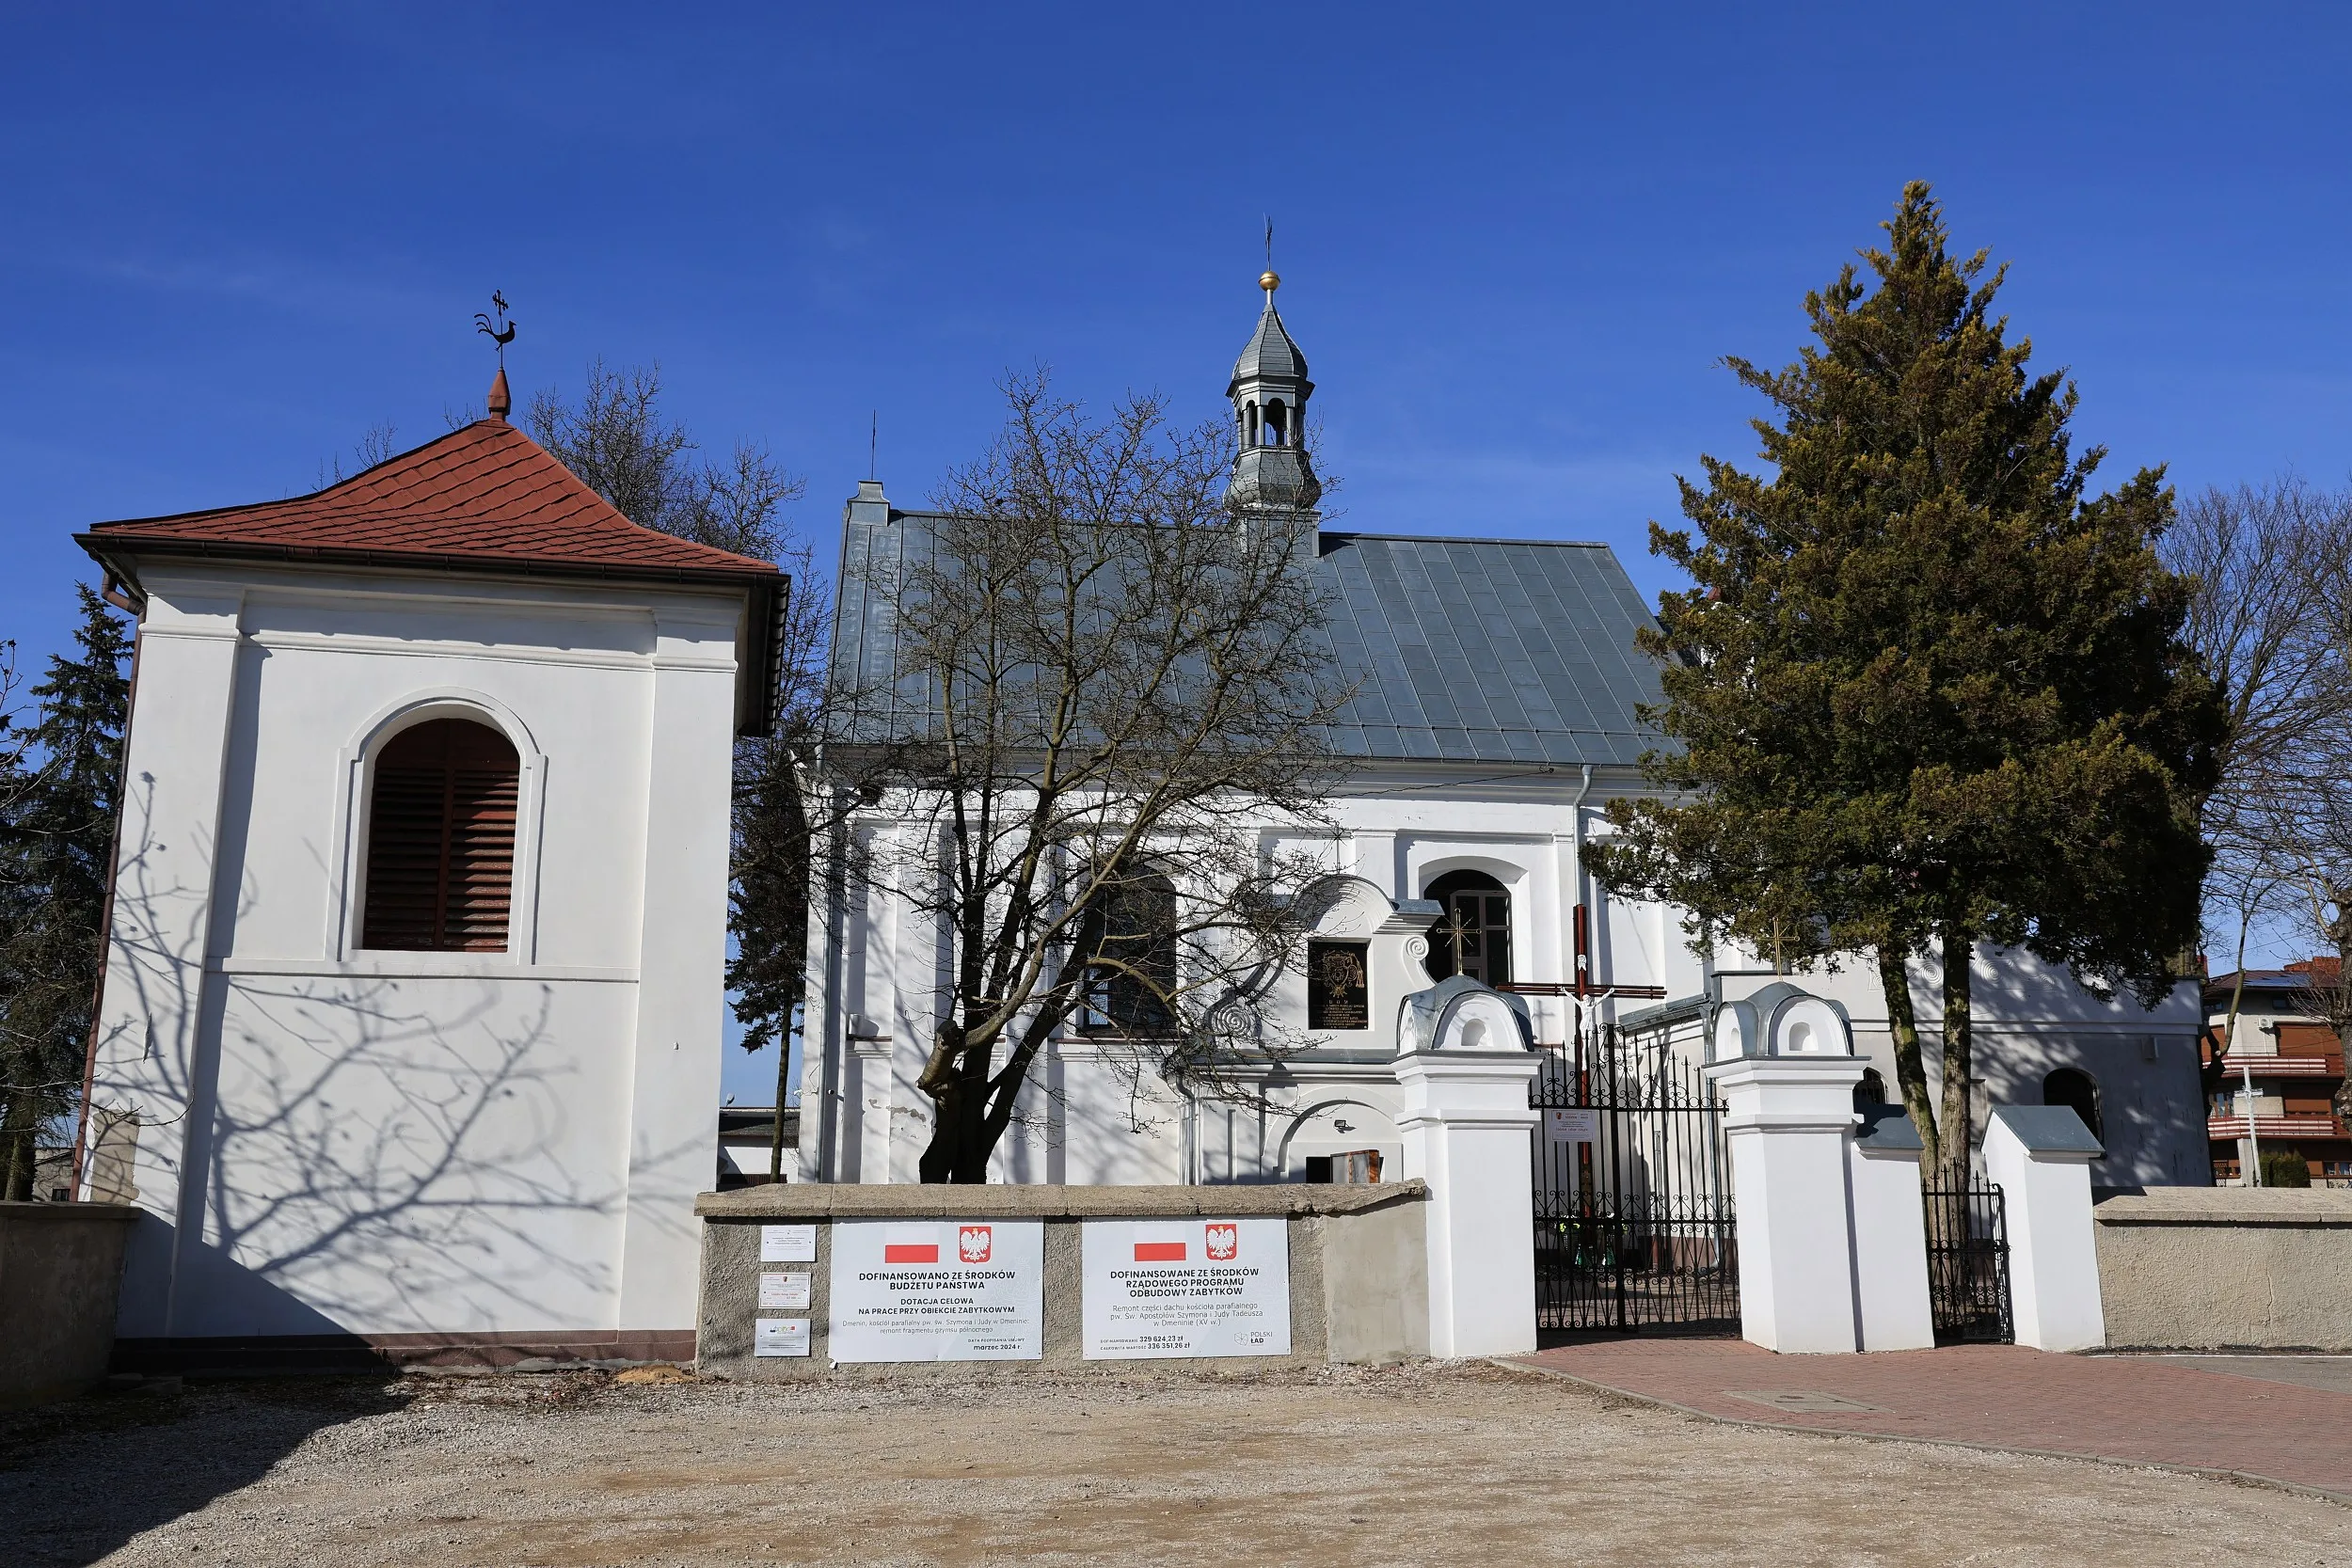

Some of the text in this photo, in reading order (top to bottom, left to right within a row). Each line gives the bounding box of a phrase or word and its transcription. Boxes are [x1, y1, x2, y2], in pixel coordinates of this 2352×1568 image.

[859, 1272, 949, 1281] DOFINANSOWANO
[965, 1269, 1016, 1279] ŚRODKÓW
[1110, 1269, 1195, 1279] DOFINANSOWANE
[1210, 1266, 1259, 1277] ŚRODKÓW
[890, 1280, 985, 1290] BUDŻETU PAŃSTWA
[1126, 1278, 1244, 1290] RZĄDOWEGO PROGRAMU
[1130, 1286, 1243, 1297] ODBUDOWY ZABYTKÓW
[1142, 1304, 1162, 1312] części
[1139, 1312, 1175, 1321] Apostołów
[1196, 1318, 1208, 1327] (XV
[1211, 1318, 1221, 1327] w.)
